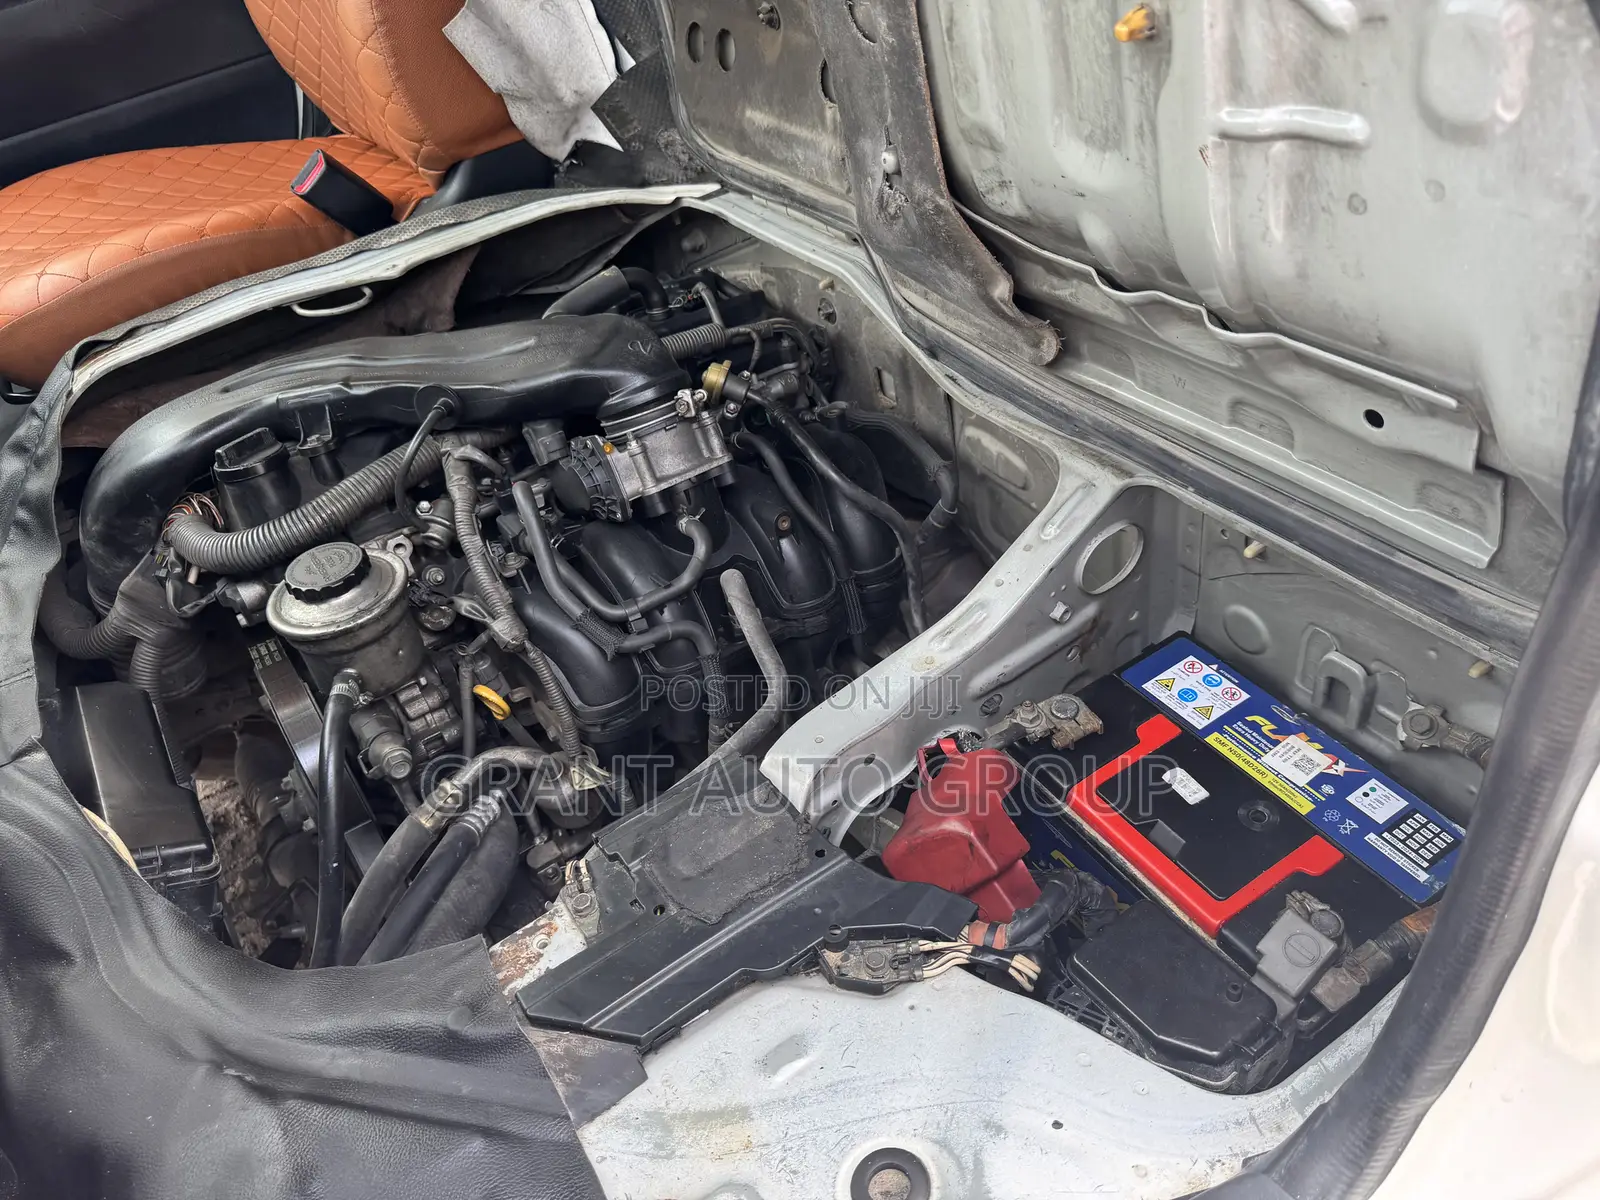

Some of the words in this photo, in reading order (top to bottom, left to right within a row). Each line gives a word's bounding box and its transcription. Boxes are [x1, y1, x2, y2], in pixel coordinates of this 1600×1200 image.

[1212, 736, 1229, 749] SMF
[1243, 732, 1260, 746] Heavy
[1408, 819, 1419, 828] APR
[1421, 828, 1432, 838] MAY
[1434, 838, 1445, 847] JUN
[1415, 814, 1426, 823] JAN
[1429, 823, 1439, 832] FEB
[1441, 832, 1453, 842] MAR
[1394, 829, 1404, 838] OCT
[1408, 840, 1418, 849] NOV
[1420, 849, 1431, 859] DEC
[1414, 834, 1425, 843] AUG
[1427, 843, 1438, 853] SEP
[1366, 836, 1389, 854] WARRANTY
[1399, 861, 1421, 879] TAMPERED
[1387, 847, 1405, 861] REMOVE
[1403, 858, 1420, 873] STICKER
